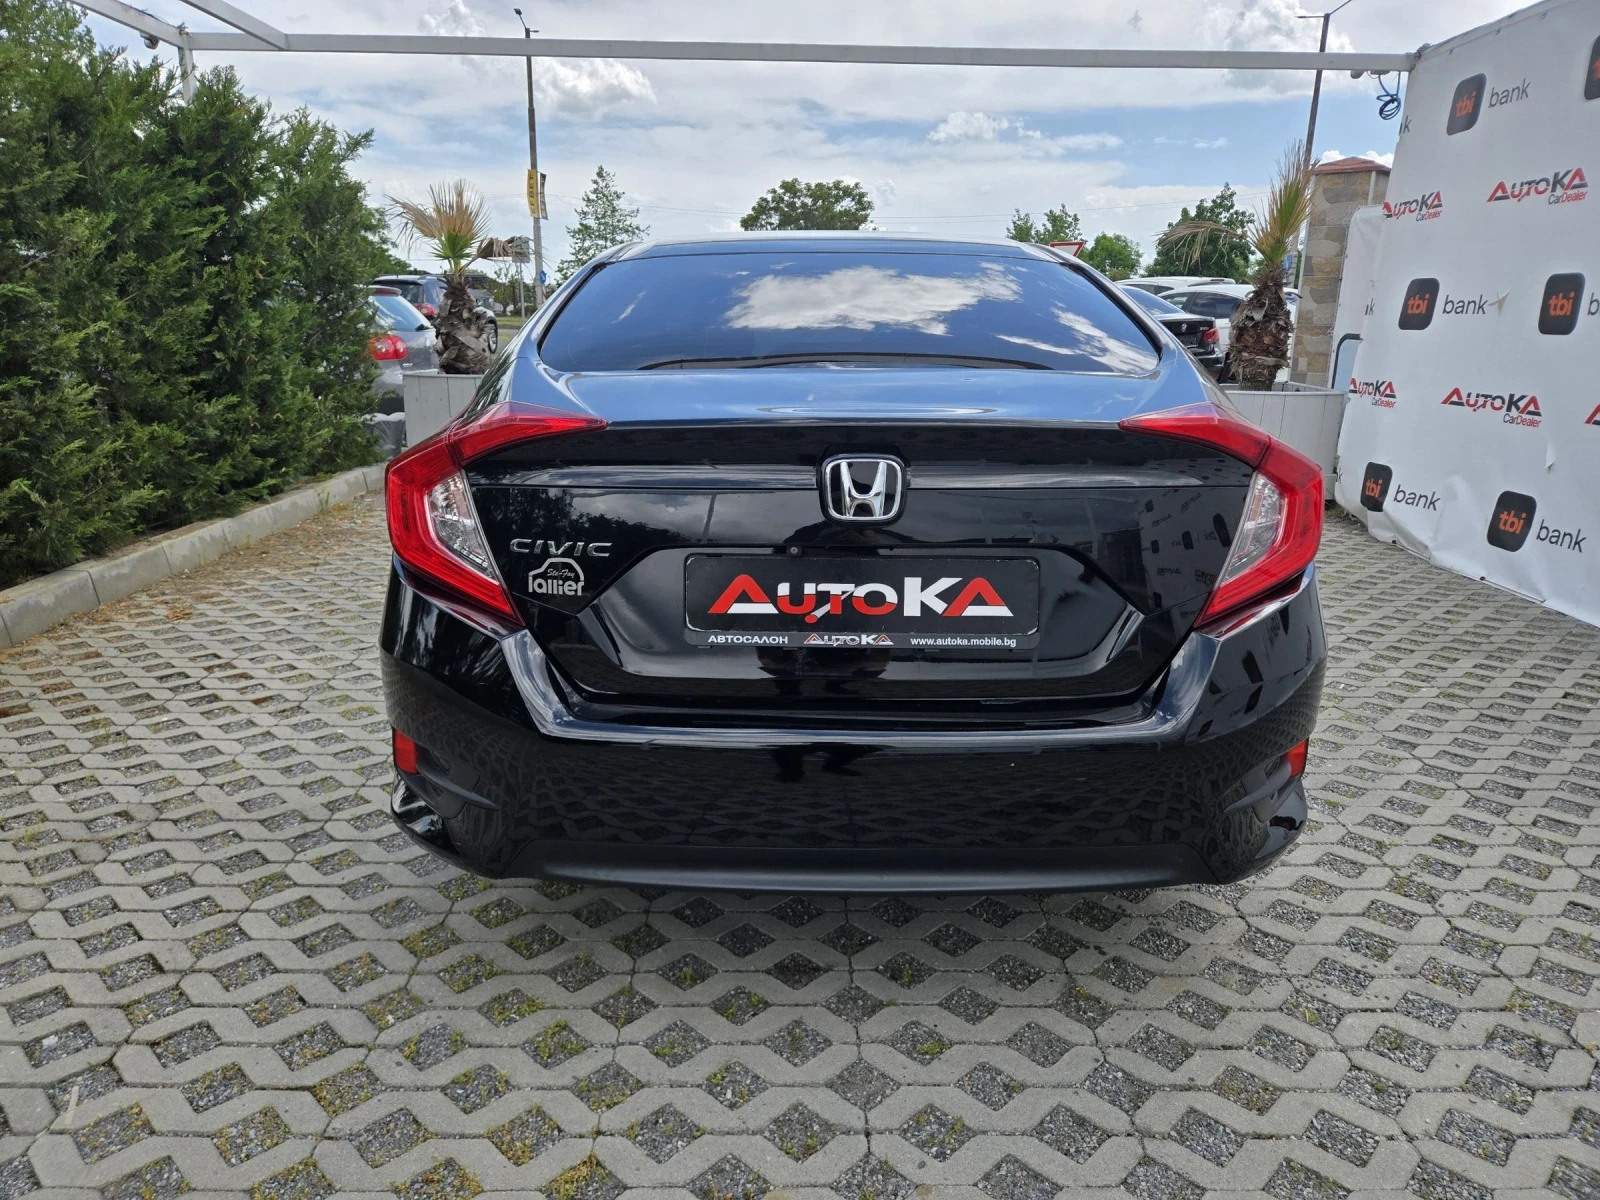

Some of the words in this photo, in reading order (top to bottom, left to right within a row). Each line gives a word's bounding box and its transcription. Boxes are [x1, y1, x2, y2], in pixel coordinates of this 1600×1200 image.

[1455, 91, 1476, 117] tbi
[1488, 78, 1532, 109] bank
[1548, 190, 1588, 205] CarDealer
[1407, 293, 1430, 314] tbi
[1442, 294, 1487, 315] bank
[1549, 291, 1575, 316] tbi
[1502, 412, 1542, 428] CarDealer
[1365, 478, 1383, 498] tbi
[1393, 483, 1441, 511] bank
[1499, 510, 1528, 535] tbi
[1535, 518, 1587, 553] bank
[509, 538, 613, 557] CIVIC
[708, 635, 789, 645] АВТОСАЛОН
[910, 636, 1017, 648] www.autoka.mobile.bg
